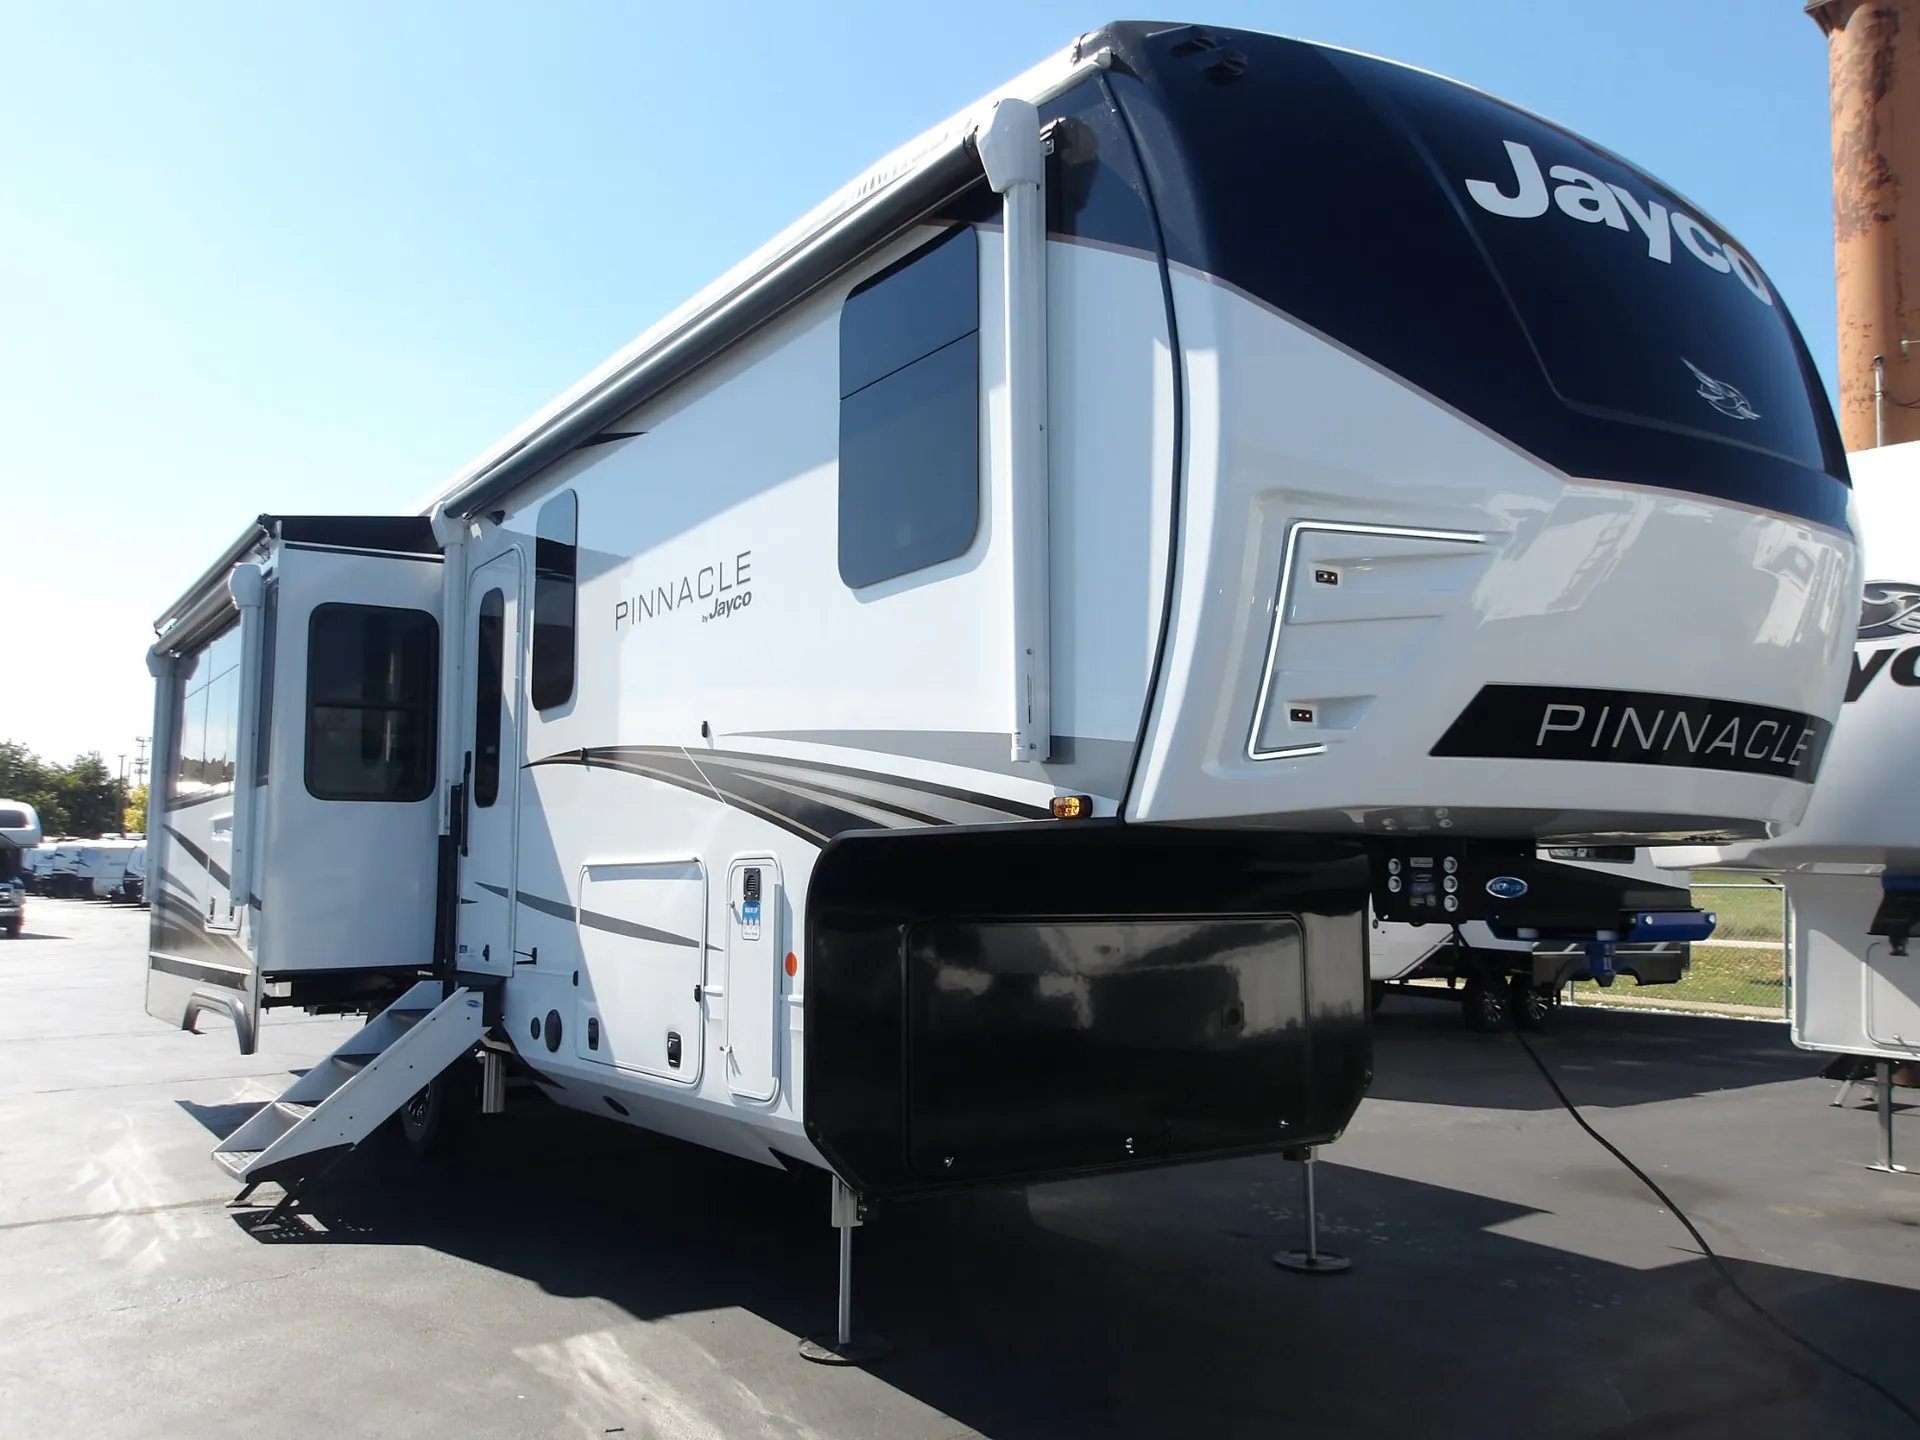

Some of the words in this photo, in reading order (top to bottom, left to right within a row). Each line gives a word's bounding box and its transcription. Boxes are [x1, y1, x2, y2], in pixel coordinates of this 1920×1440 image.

[1465, 140, 1773, 305] Jayco
[615, 550, 751, 631] PINNACLE
[709, 591, 752, 619] Jayco
[1536, 703, 1815, 766] PINNACLE
